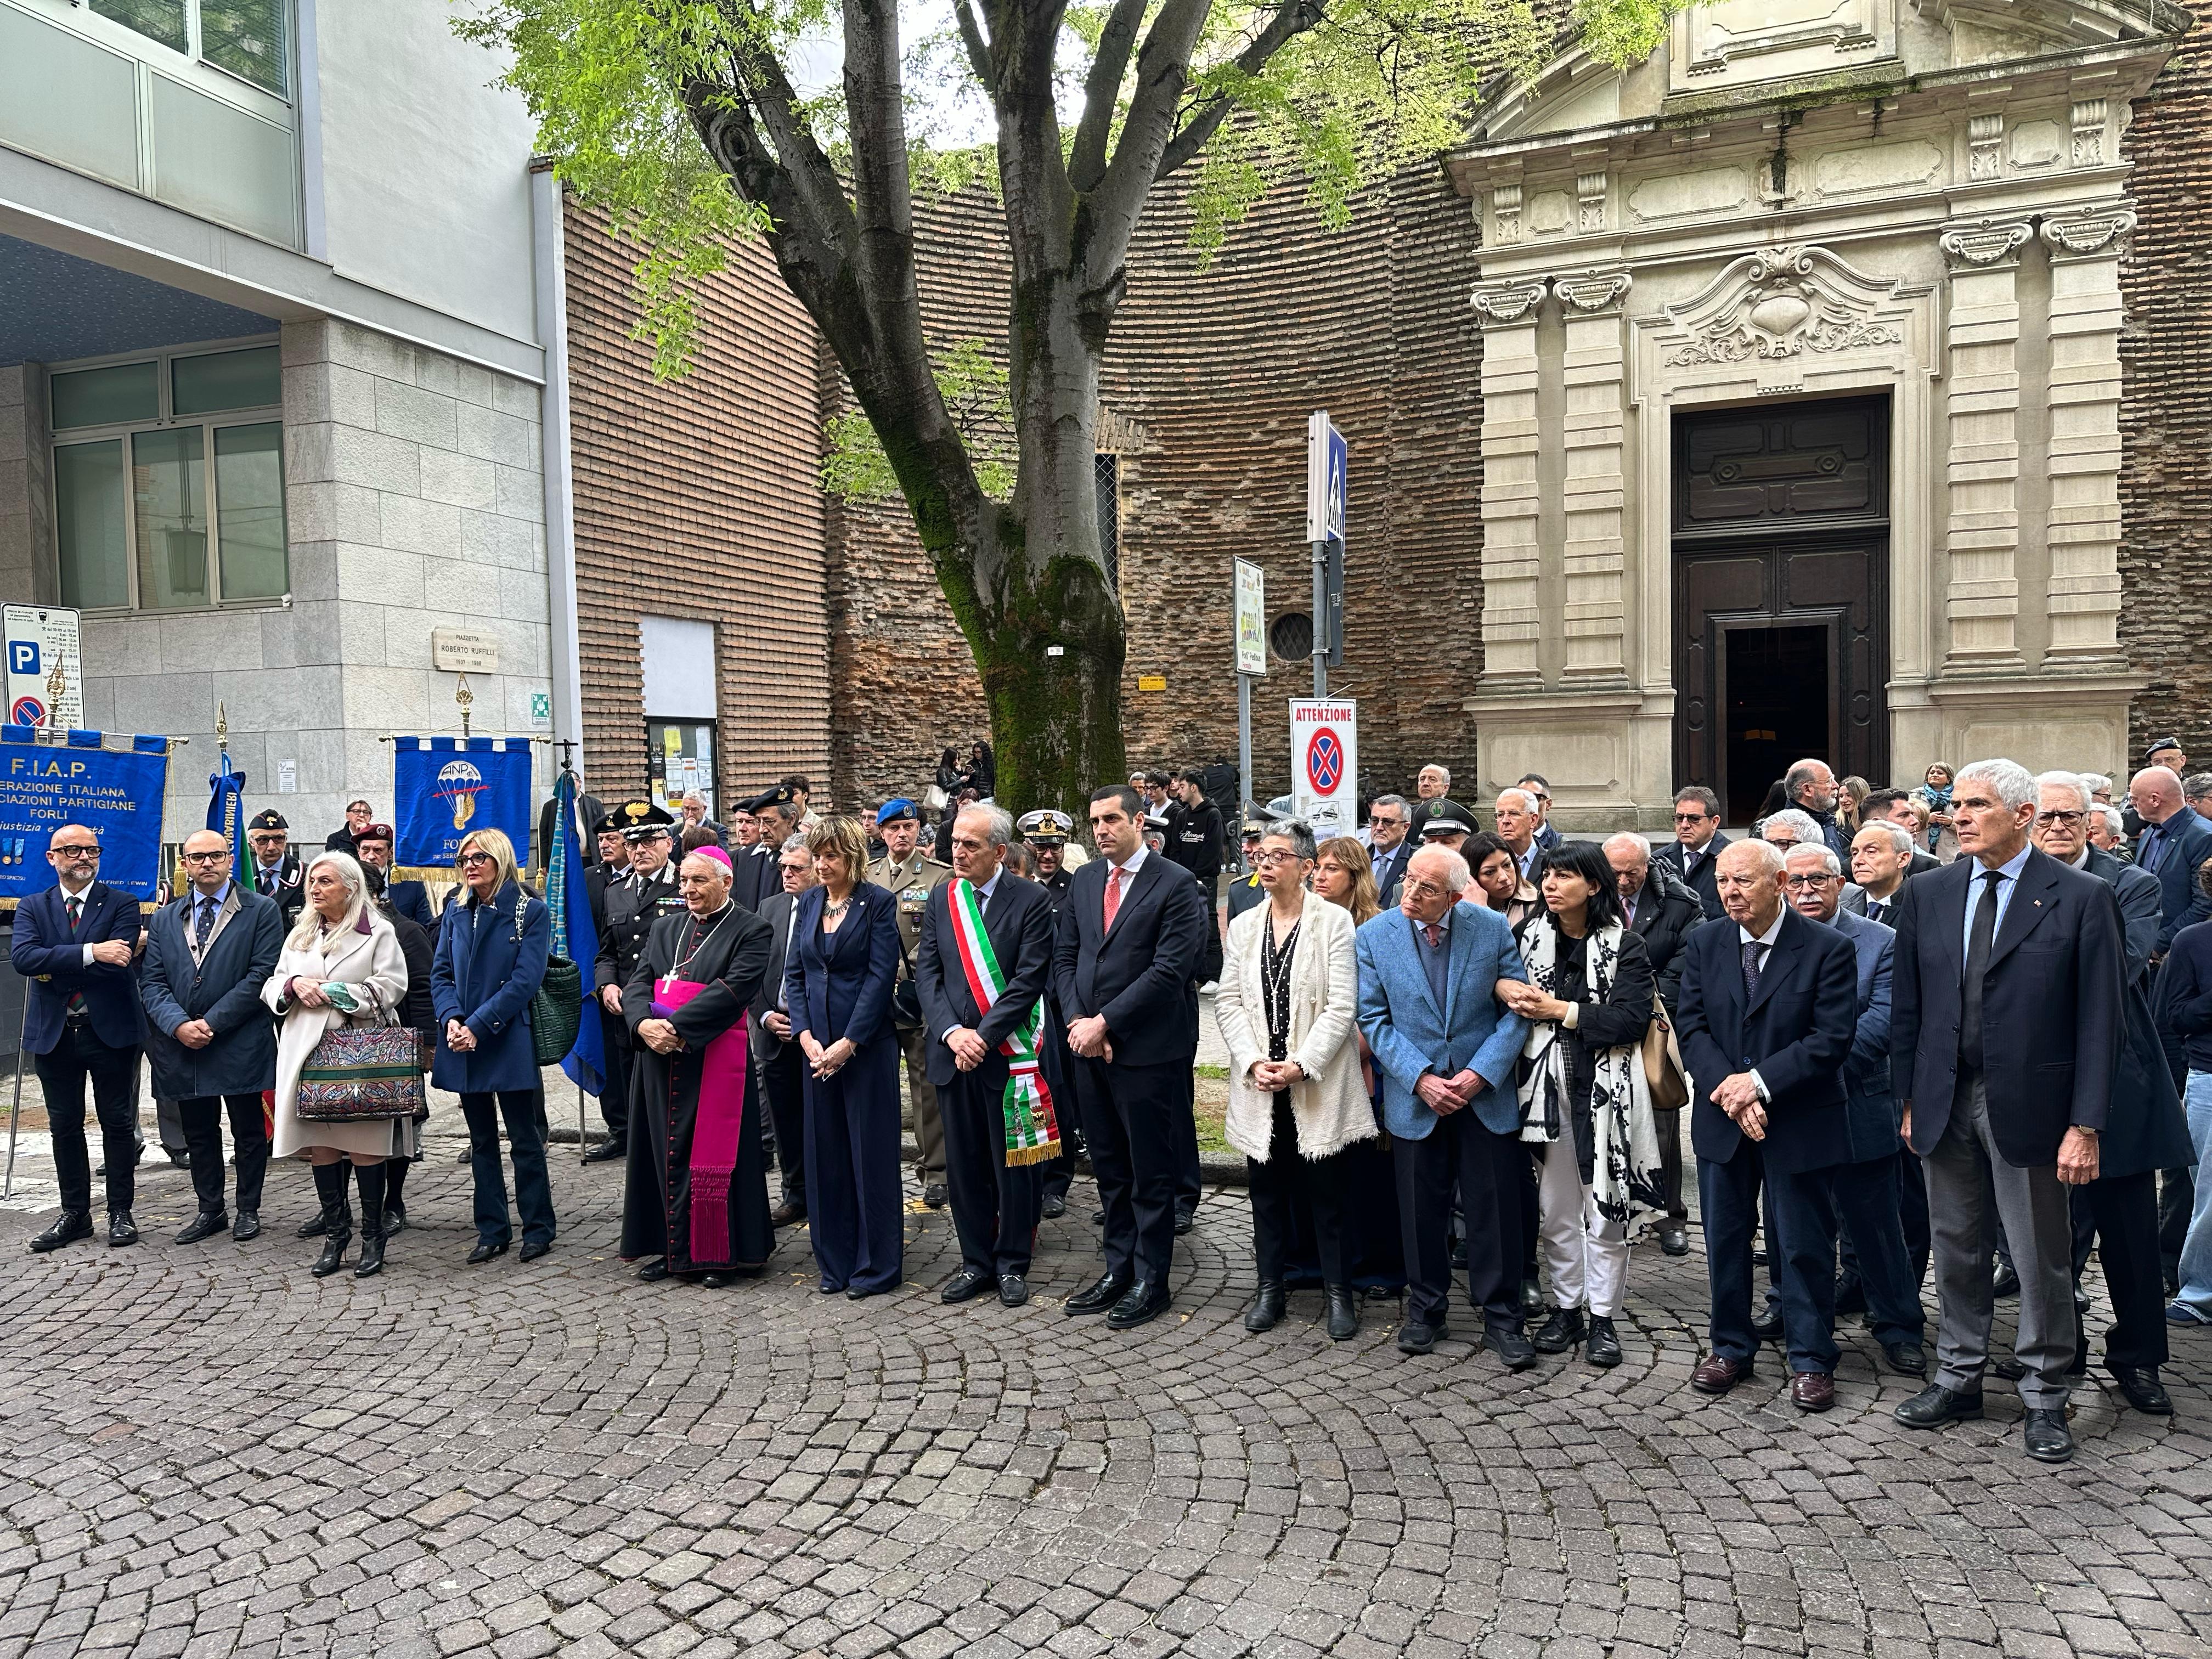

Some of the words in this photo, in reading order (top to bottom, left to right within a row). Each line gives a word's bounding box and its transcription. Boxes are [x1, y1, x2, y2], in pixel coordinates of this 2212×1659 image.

[441, 645, 468, 653] ROBERTO
[471, 647, 494, 656] RUFFILLI
[16, 646, 33, 670] P
[1296, 708, 1351, 721] ATTENZIONE
[11, 758, 92, 780] F.I.A.P.
[0, 781, 63, 794] ERAZIONE
[70, 785, 127, 798] ITALIANA
[59, 797, 136, 811] PARTIGIANE
[30, 809, 67, 820] FORLI
